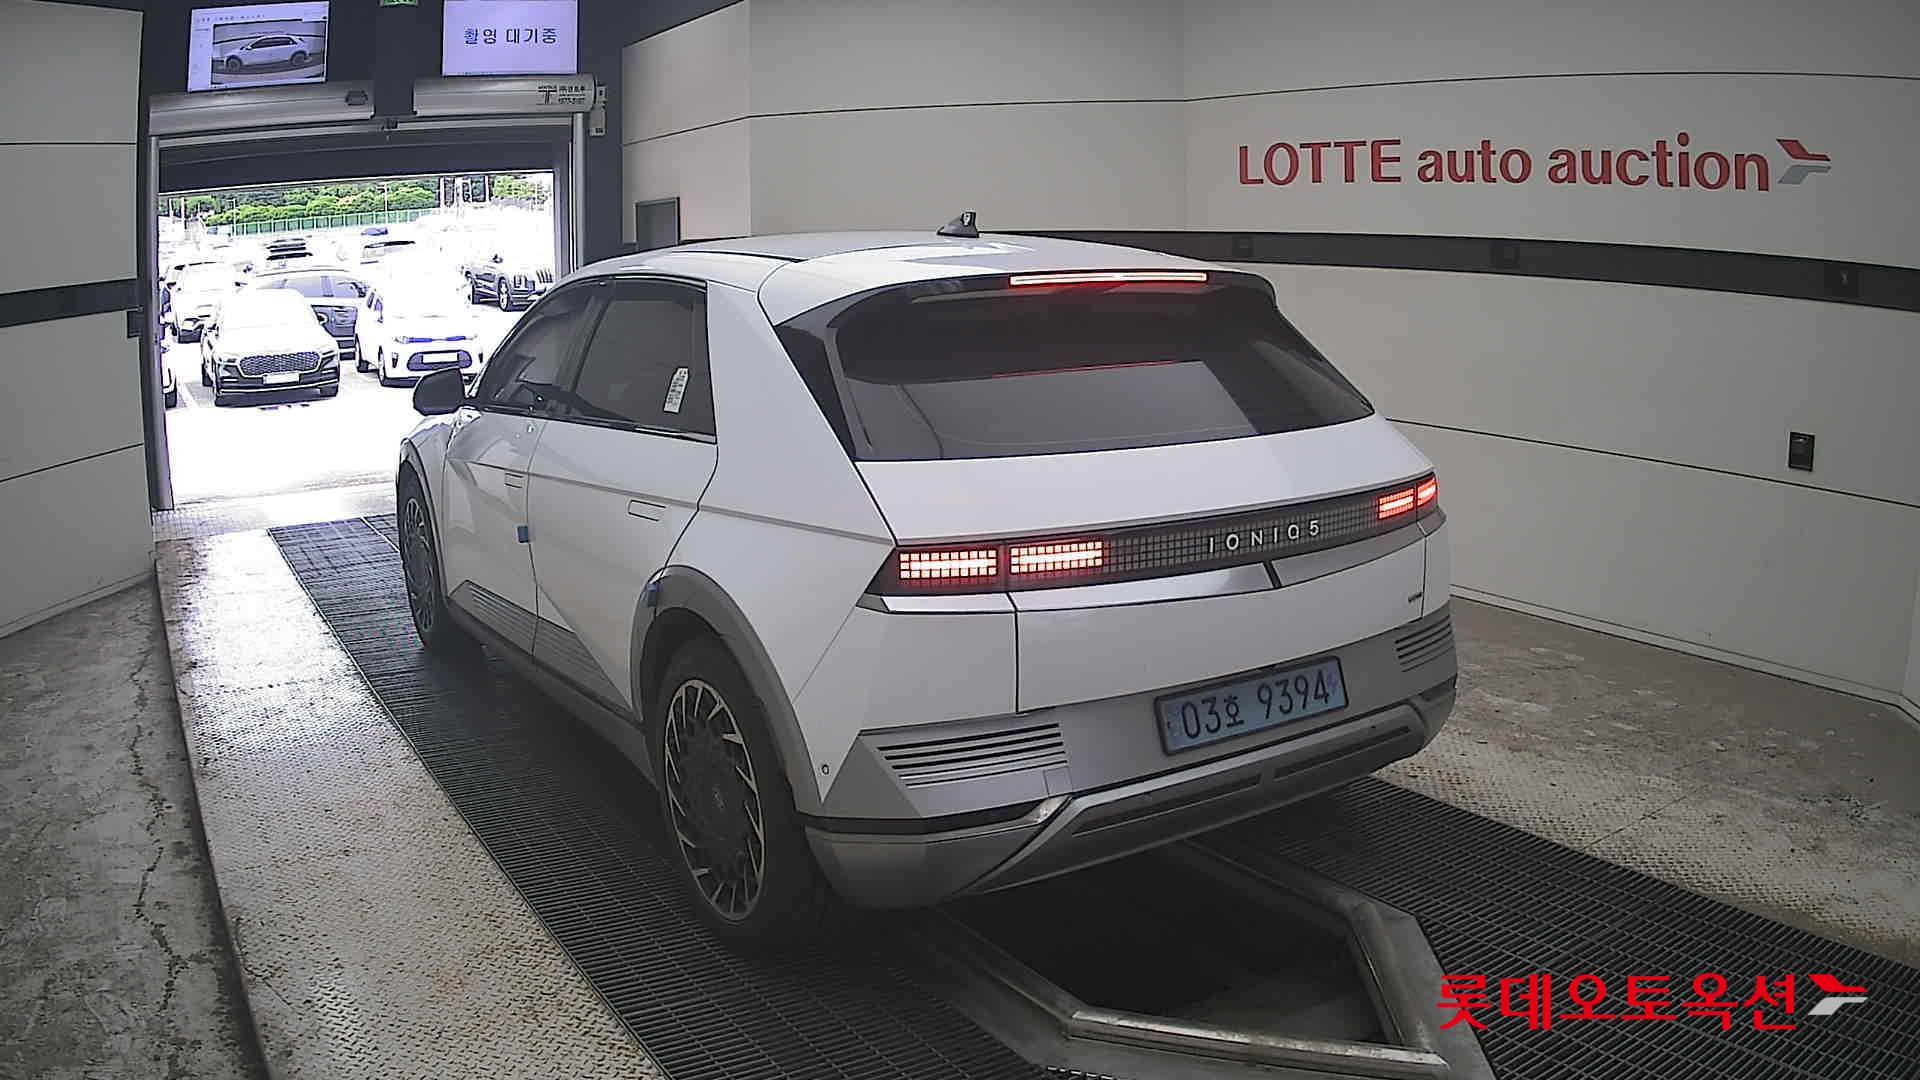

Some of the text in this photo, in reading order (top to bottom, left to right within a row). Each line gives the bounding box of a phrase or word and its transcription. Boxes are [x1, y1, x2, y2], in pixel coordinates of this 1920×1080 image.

[505, 27, 558, 45] 대기중
[1238, 131, 1771, 192] LOTTE auto auction
[1181, 669, 1330, 740] 03호 9394
